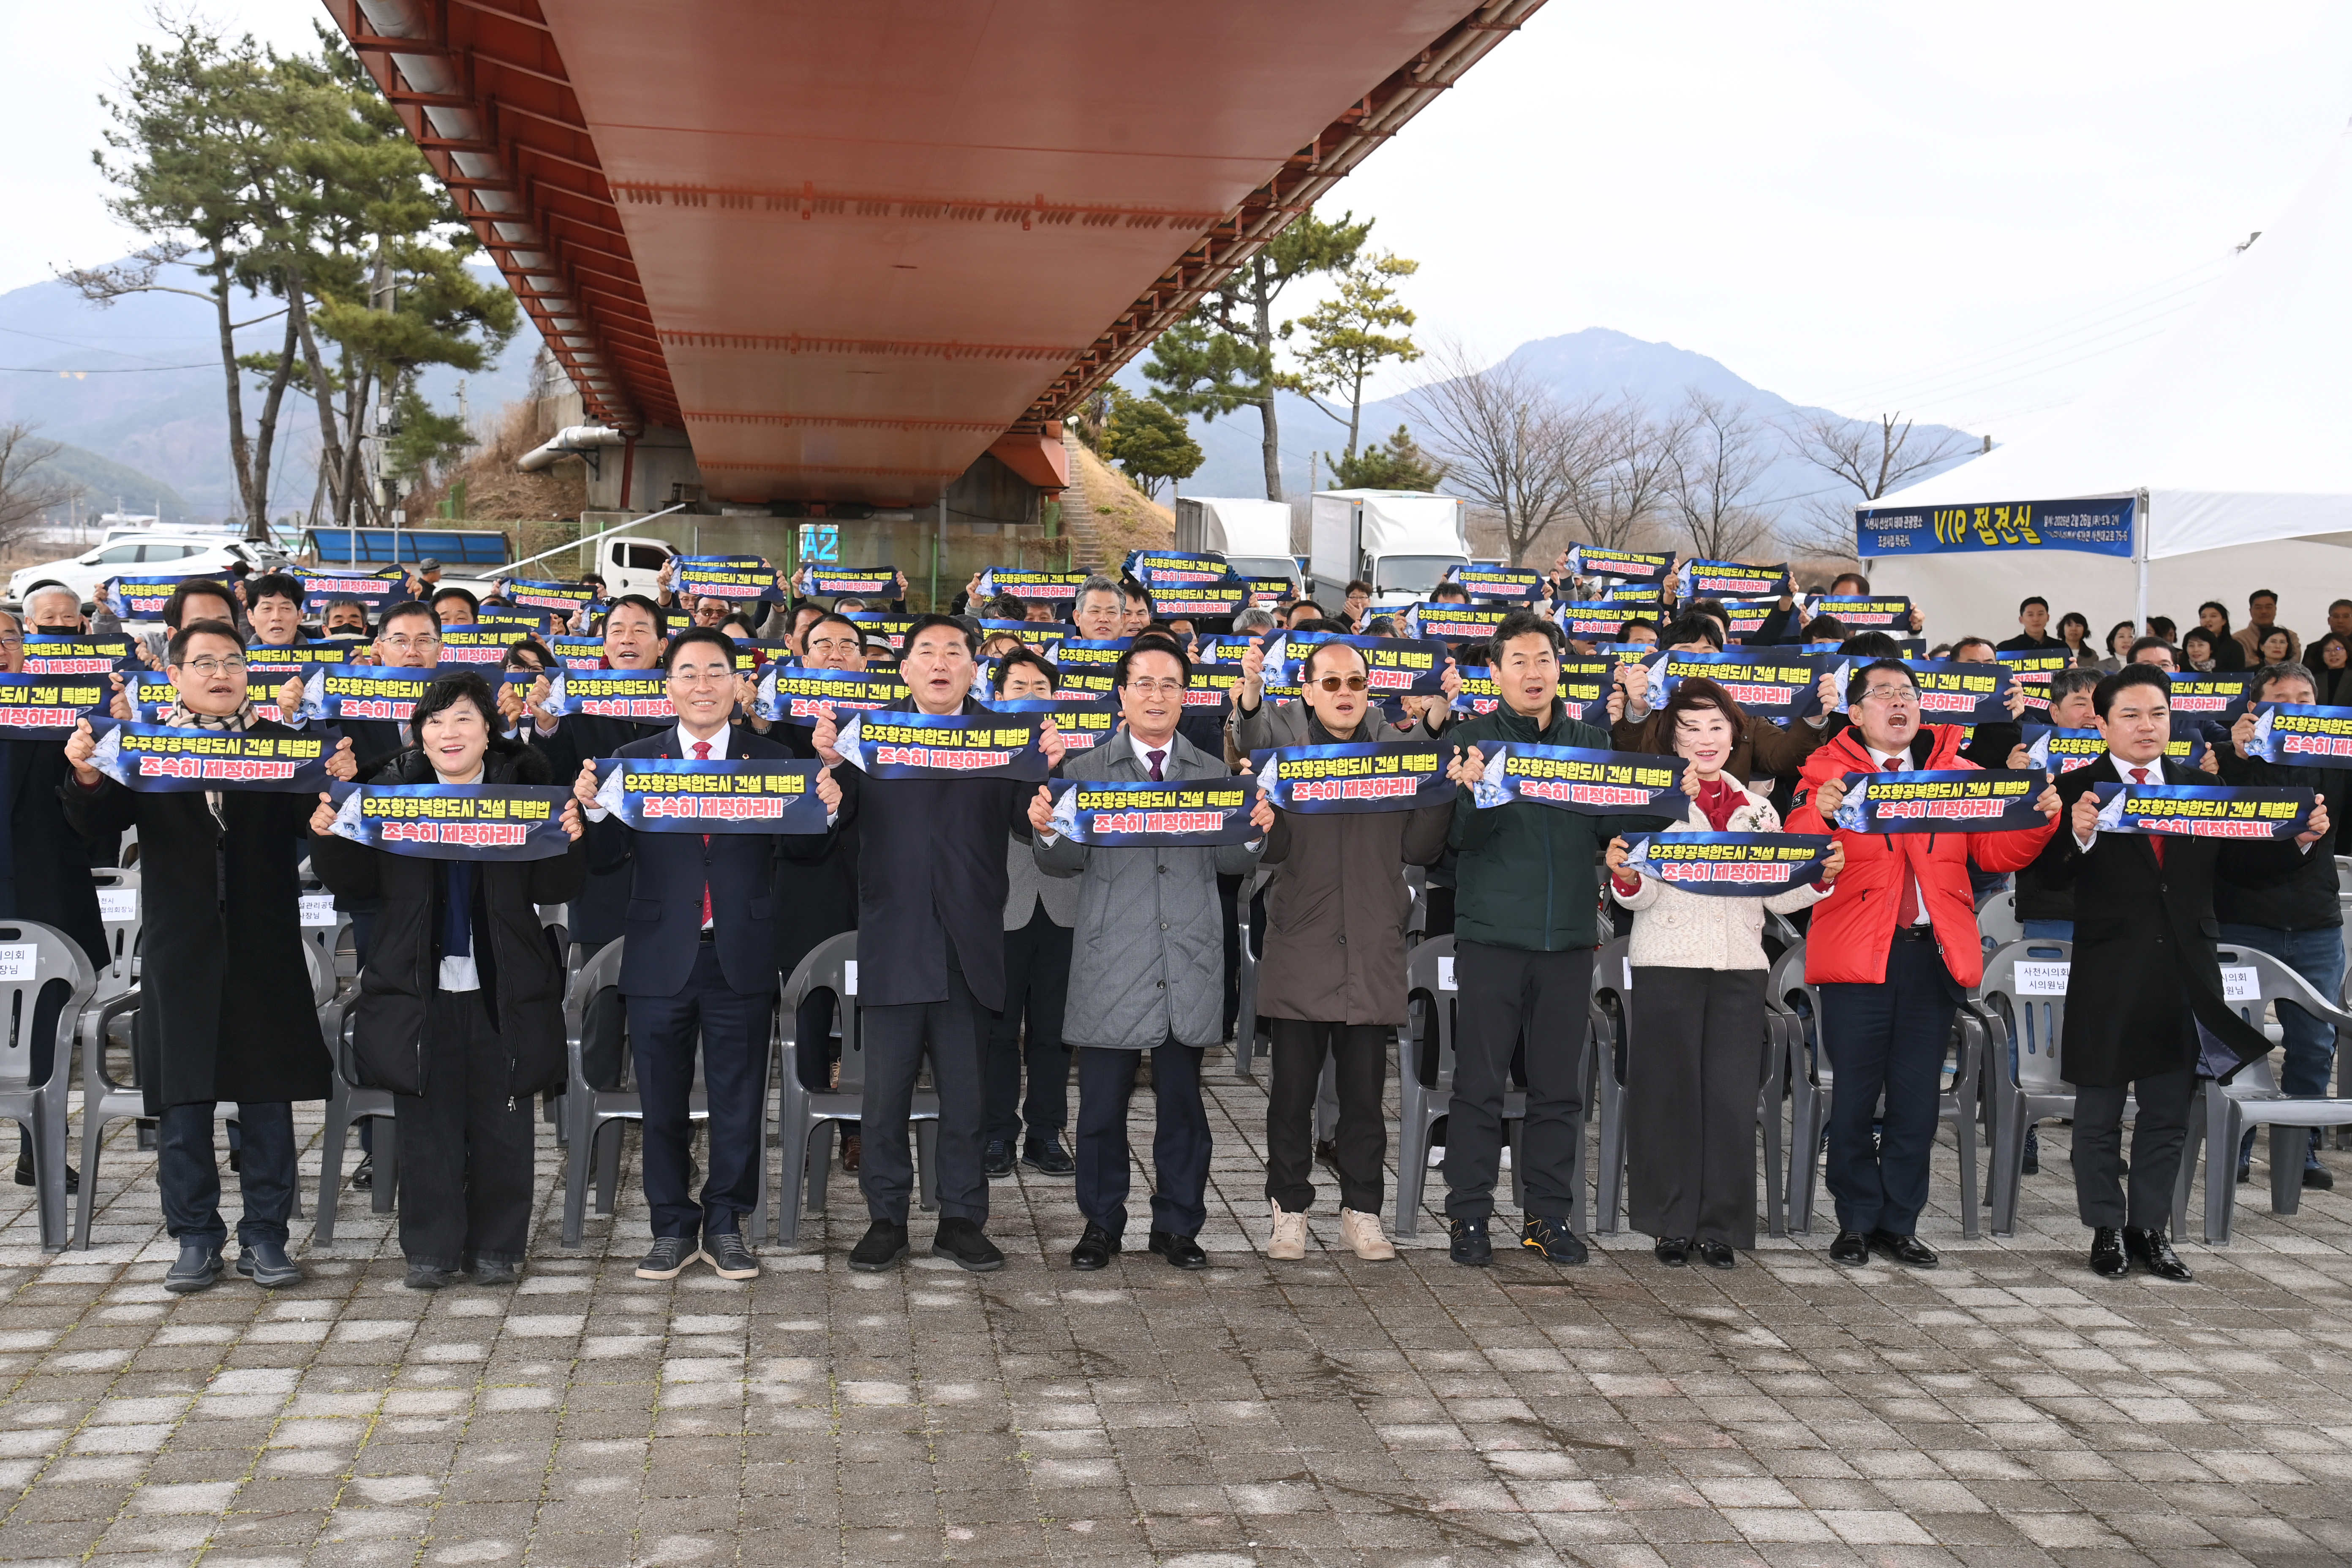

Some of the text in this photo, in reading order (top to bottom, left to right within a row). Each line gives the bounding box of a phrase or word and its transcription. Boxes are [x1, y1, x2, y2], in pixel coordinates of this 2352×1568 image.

[1934, 509, 1967, 544] VIP
[2071, 514, 2079, 527] 2월
[802, 526, 837, 560] A2
[2115, 530, 2128, 542] 75-6
[1581, 549, 1665, 565] 우주항공복합도시 건설 특별법
[1145, 558, 1227, 574] 우주항공복합도시 건설 특별법
[1587, 560, 1653, 574] 조속히 제정하라!!
[1692, 566, 1783, 579] 우주항공복합도시 건설 특별법
[682, 571, 773, 585] 우주항공복합도시 건설 특별법
[814, 572, 860, 580] 우주항공복합도시
[993, 574, 1064, 583] 우주항공복합도시 건설
[1461, 573, 1536, 584] 우주항공복합도시 건설 특별법
[306, 580, 388, 592] 조속히 제정하라!!
[511, 585, 560, 597] 우주항공복합도시
[574, 591, 593, 600] 특별법
[690, 584, 760, 596] 조속히 제정하라!!
[821, 581, 882, 591] 조속히 제정하라!!
[1032, 586, 1075, 597] 제정하라!!
[1467, 583, 1525, 593] 조속히 제정하라!!
[1699, 579, 1770, 591] 조속히 제정하라!!
[517, 595, 580, 609] 조속히 제정하라!!
[1206, 590, 1242, 600] 건설 특별법
[1157, 602, 1230, 613] 조속히 제정하라!!
[1566, 608, 1620, 620] 우주항공복합도시
[1820, 603, 1905, 612] 우주항공복합도시 건설 특별법
[1419, 610, 1474, 622] 우주항공복합도시
[1853, 614, 1892, 623] 제정하라!!
[1427, 623, 1455, 634] 조속히
[1573, 621, 1601, 632] 조속히
[74, 644, 127, 656] 건설 특별법
[49, 659, 112, 673] 제정하라!!
[1376, 651, 1432, 669] 건설 특별법
[1667, 663, 1811, 683] 우주항공복합도시 건설 특별법
[326, 678, 423, 697] 우주항공복합도시
[567, 680, 659, 696] 우주항공복합도시
[778, 678, 891, 700] 우주항공복합도시 건설
[1064, 675, 1114, 691] 건설 특별법
[1938, 674, 1996, 692] 건설 특별법
[2195, 682, 2243, 694] 건설 특별법
[31, 687, 58, 704] 건설
[62, 687, 101, 704] 특별법
[342, 700, 390, 717] 조속히
[583, 700, 628, 716] 조속히
[1055, 713, 1111, 729] 건설 특별법
[862, 724, 1029, 747] 우주항공복합도시 건설 특별법
[122, 736, 321, 757] 우주항공복합도시 건설 특별법
[2285, 736, 2330, 753] 조속히
[879, 748, 1008, 768] 조속히 제정하라!!
[142, 757, 294, 778] 조속히 제정하라!!
[1279, 754, 1437, 779] 우주항공복합도시 건설 특별법
[1507, 757, 1672, 787] 우주항공복합도시 건설 특별법
[626, 774, 804, 793] 우주항공복합도시 건설 특별법
[1293, 778, 1416, 800] 조속히 제정하라!!
[1867, 781, 2030, 800] 우주항공복합도시 건설 특별법
[1078, 790, 1244, 809] 우주항공복합도시 건설 특별법
[1521, 781, 1648, 804] 조속히 제정하라!!
[364, 798, 550, 819] 우주항공복합도시 건설 특별법
[645, 797, 781, 817] 조속히 제정하라!!
[1878, 800, 2004, 817] 조속히 제정하라!!
[2126, 799, 2298, 818] 우주항공복합도시 건설 특별법
[1094, 812, 1222, 832] 조속히 제정하라!!
[384, 822, 525, 844] 조속히 제정하라!!
[1649, 844, 1815, 860] 우주항공복합도시 건설 특별법
[1663, 863, 1789, 881] 조속히 제정하라!!
[2024, 967, 2069, 977] 사천시의회
[2029, 980, 2065, 990] 시의원님
[2226, 985, 2244, 995] 원님
